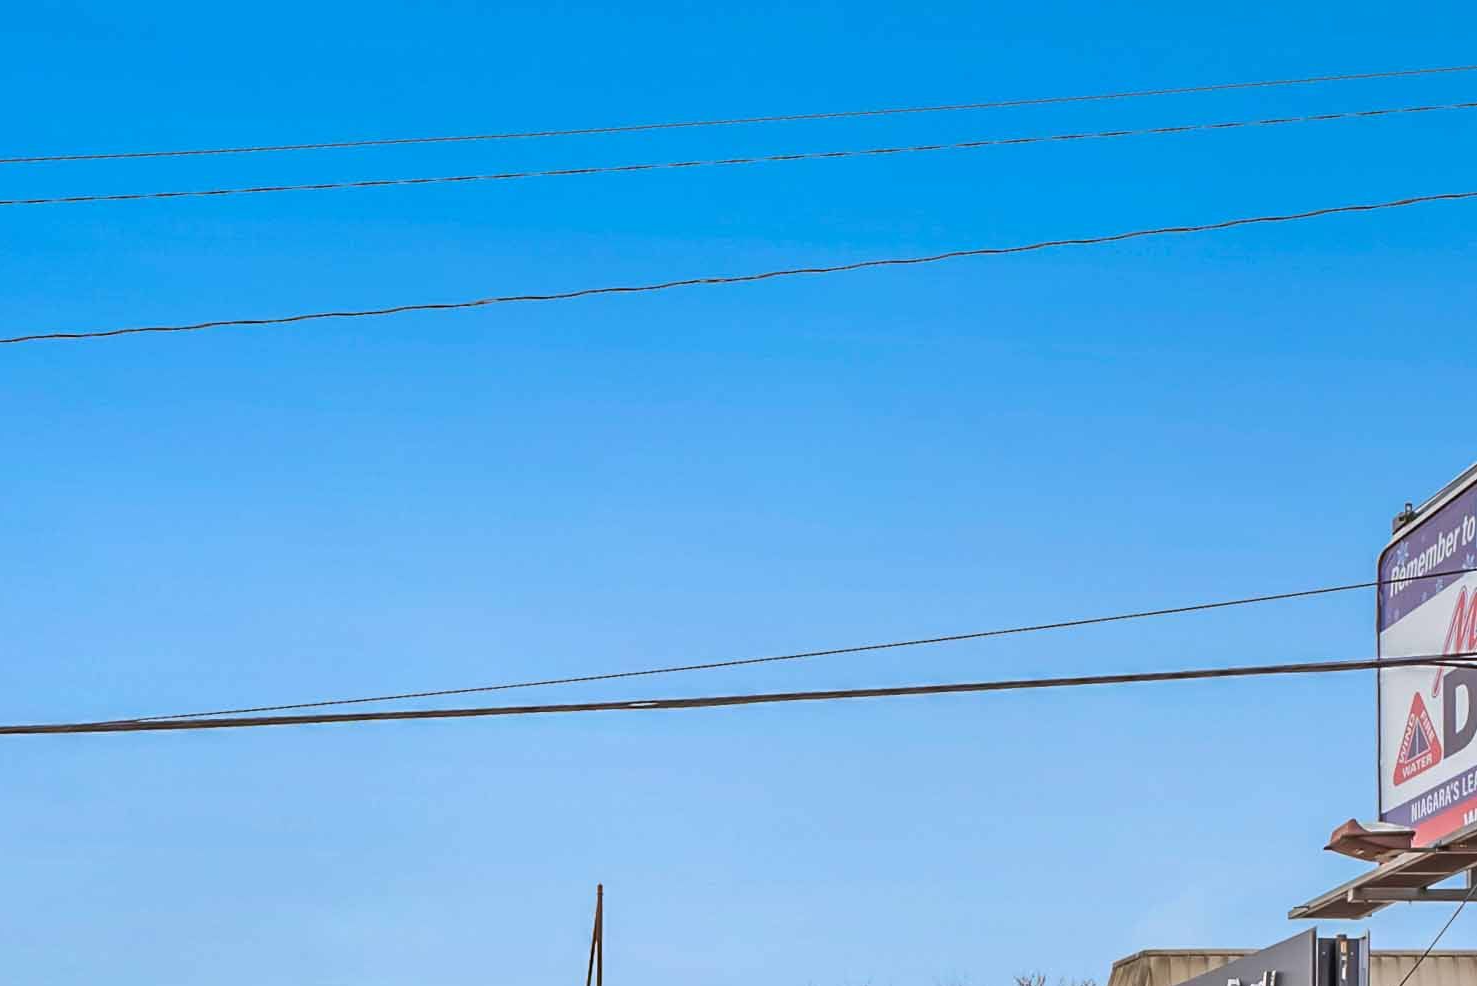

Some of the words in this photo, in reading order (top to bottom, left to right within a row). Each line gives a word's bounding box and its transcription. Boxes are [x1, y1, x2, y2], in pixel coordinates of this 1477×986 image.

[1390, 524, 1460, 598] Remember
[1461, 514, 1476, 547] to
[1398, 712, 1415, 764] WIND
[1402, 753, 1433, 779] WATER
[1411, 780, 1460, 824] NIAGARA'S
